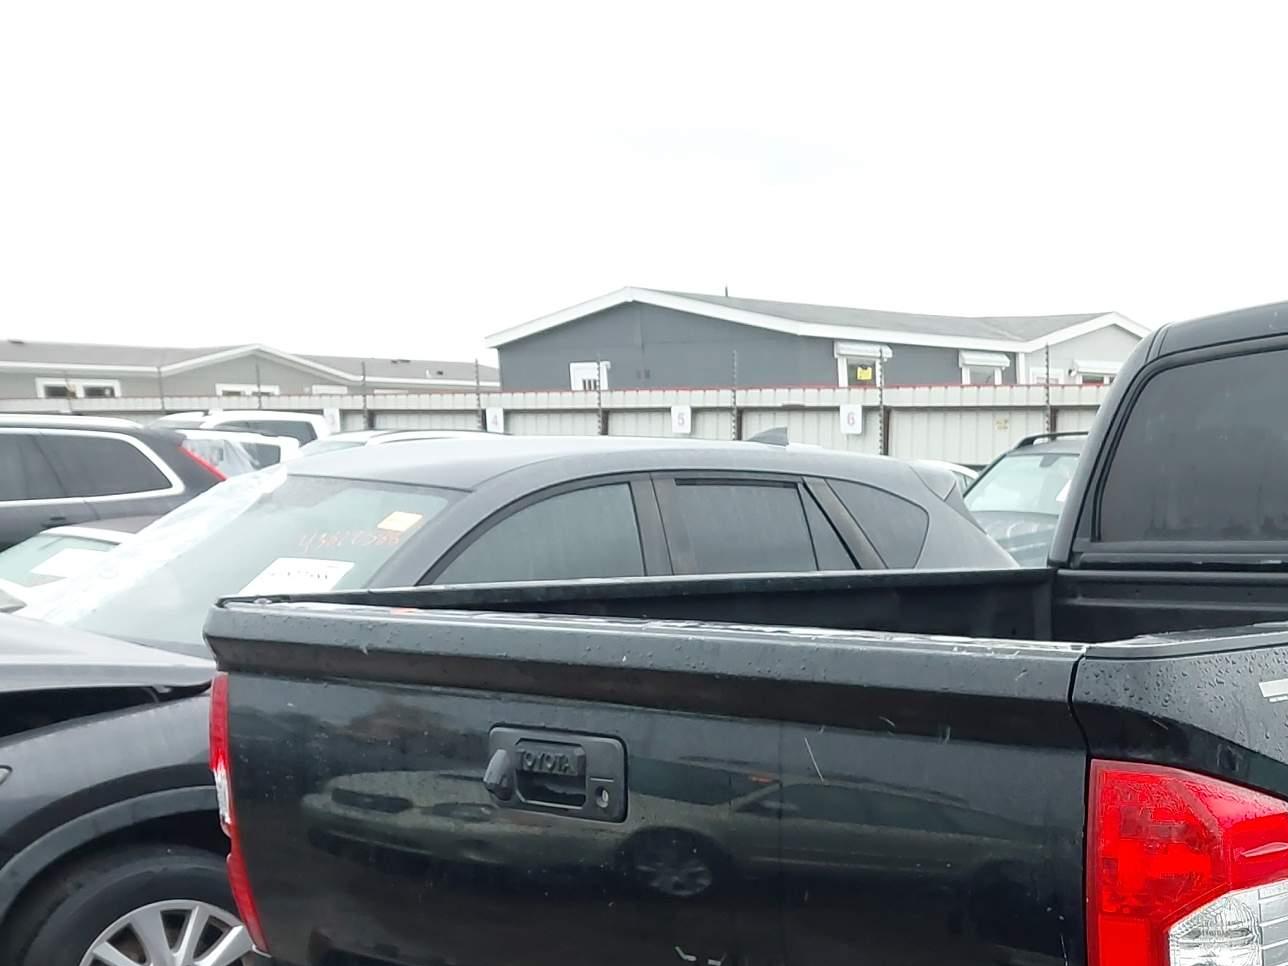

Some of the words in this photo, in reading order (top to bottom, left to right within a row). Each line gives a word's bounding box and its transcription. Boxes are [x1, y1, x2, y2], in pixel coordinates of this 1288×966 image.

[677, 412, 685, 427] 5
[847, 412, 855, 427] 6
[516, 748, 579, 777] TOYOTA
